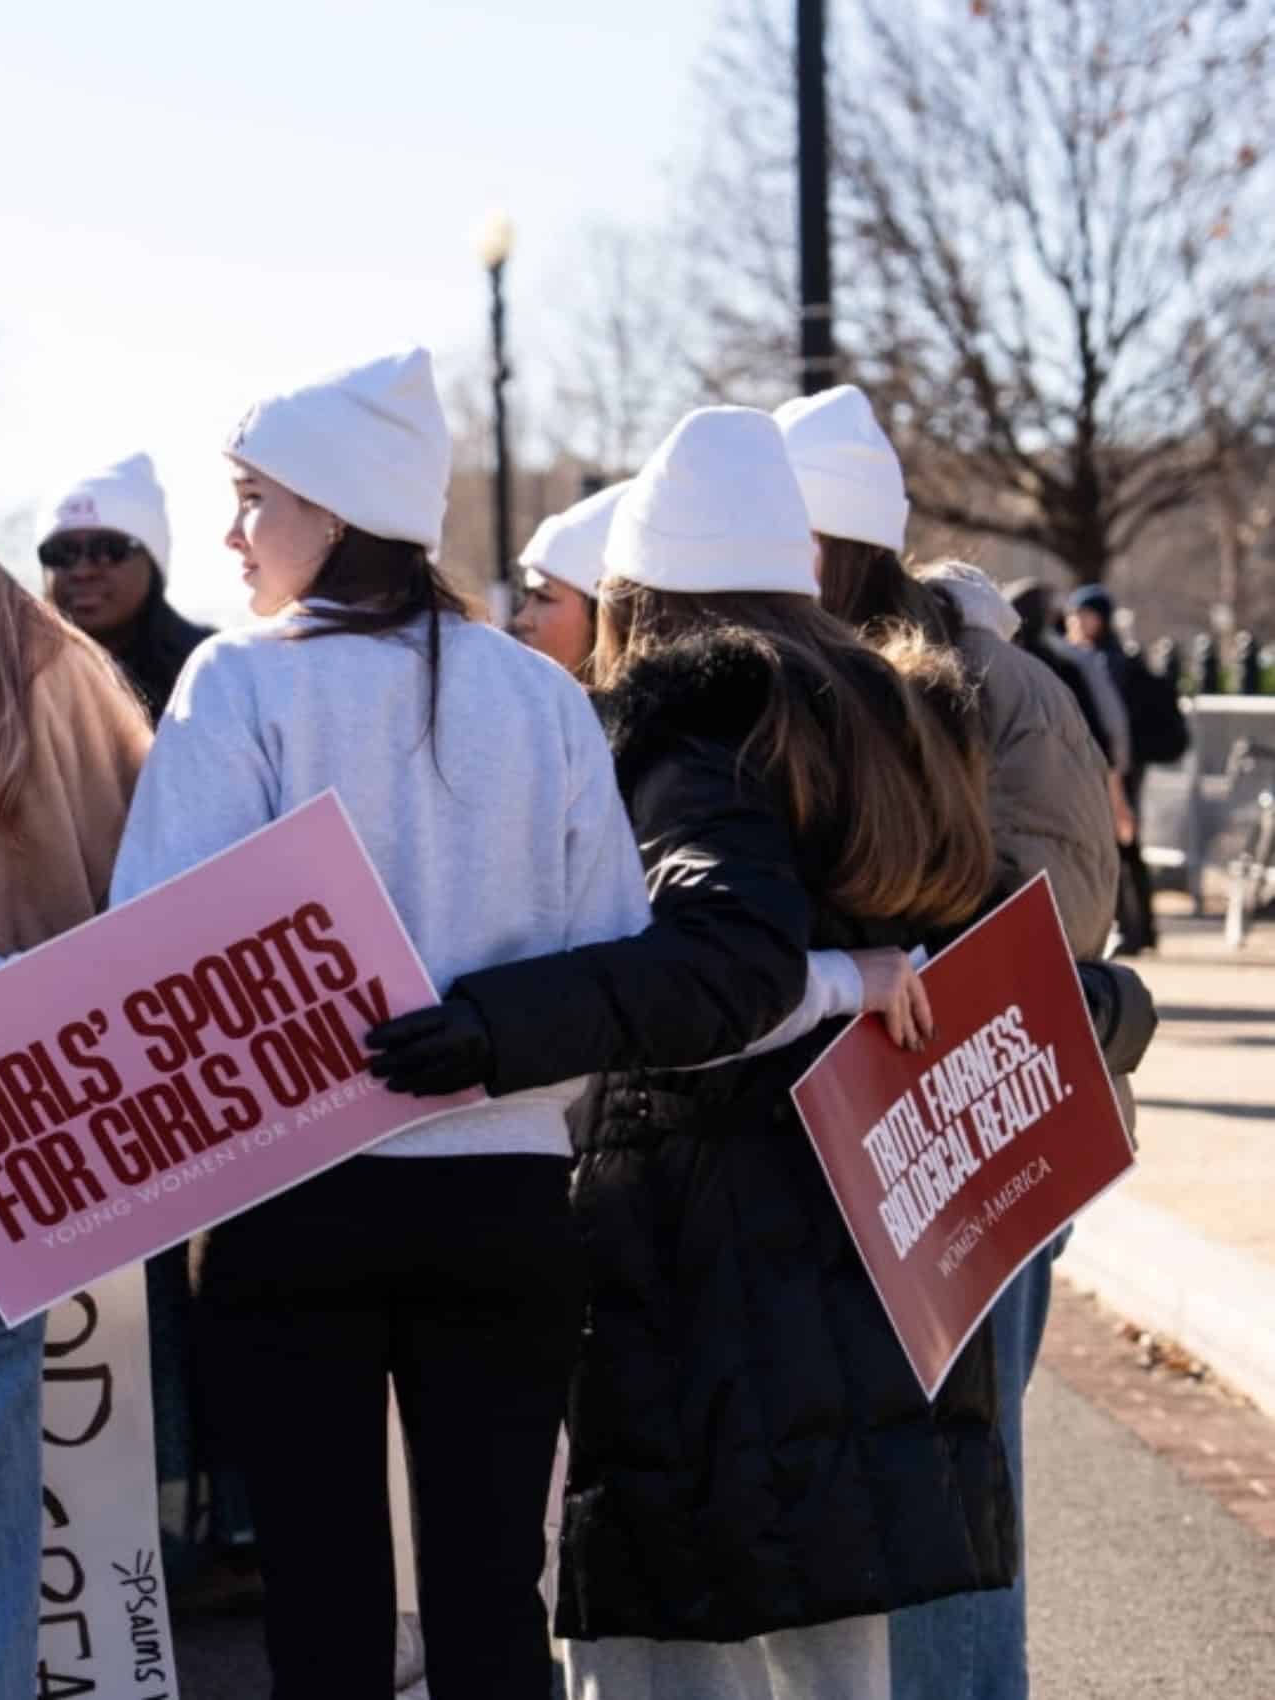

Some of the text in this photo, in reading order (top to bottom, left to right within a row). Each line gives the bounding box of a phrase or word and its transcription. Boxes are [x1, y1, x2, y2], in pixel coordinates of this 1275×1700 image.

[122, 901, 357, 1073] SPORTS
[41, 1078, 381, 1249] YOUNG WOMEN FOR AMERIC
[88, 1053, 263, 1187] GIRLS
[862, 1004, 1039, 1190] TRUTH. FAIRNESS.
[877, 1044, 1073, 1261] BIOLOGICAL REALITY.
[937, 1155, 1053, 1277] WOMEN AMERICA
